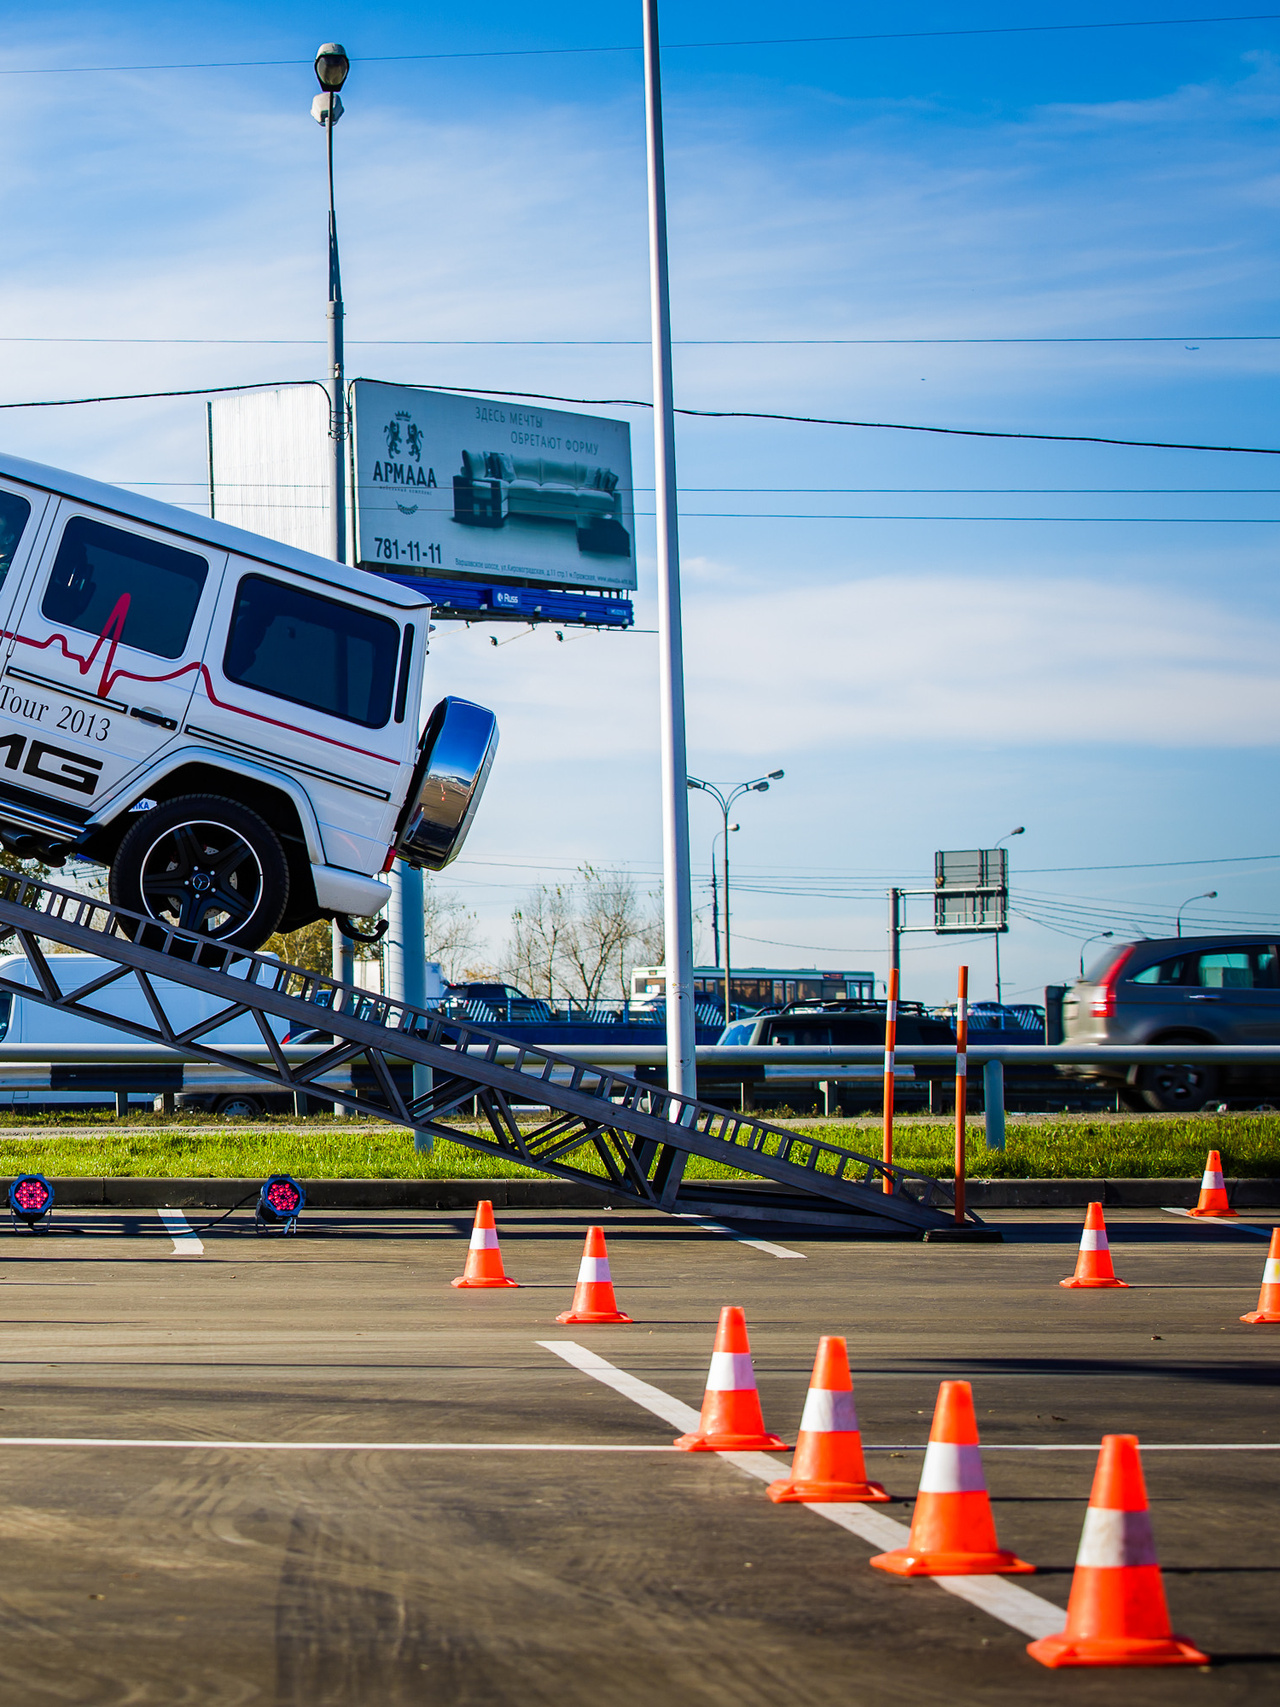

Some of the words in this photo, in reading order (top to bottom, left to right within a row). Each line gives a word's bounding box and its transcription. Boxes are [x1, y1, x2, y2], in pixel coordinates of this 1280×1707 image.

[475, 406, 505, 424] ЗДЕСЬ
[509, 412, 543, 429] МЕЧТЫ
[510, 430, 562, 450] ОБРЕТАЮТ
[565, 439, 600, 456] ФОРМУ
[372, 460, 438, 488] АРМАДА
[374, 537, 442, 564] 781-11-11
[56, 705, 111, 741] 2013
